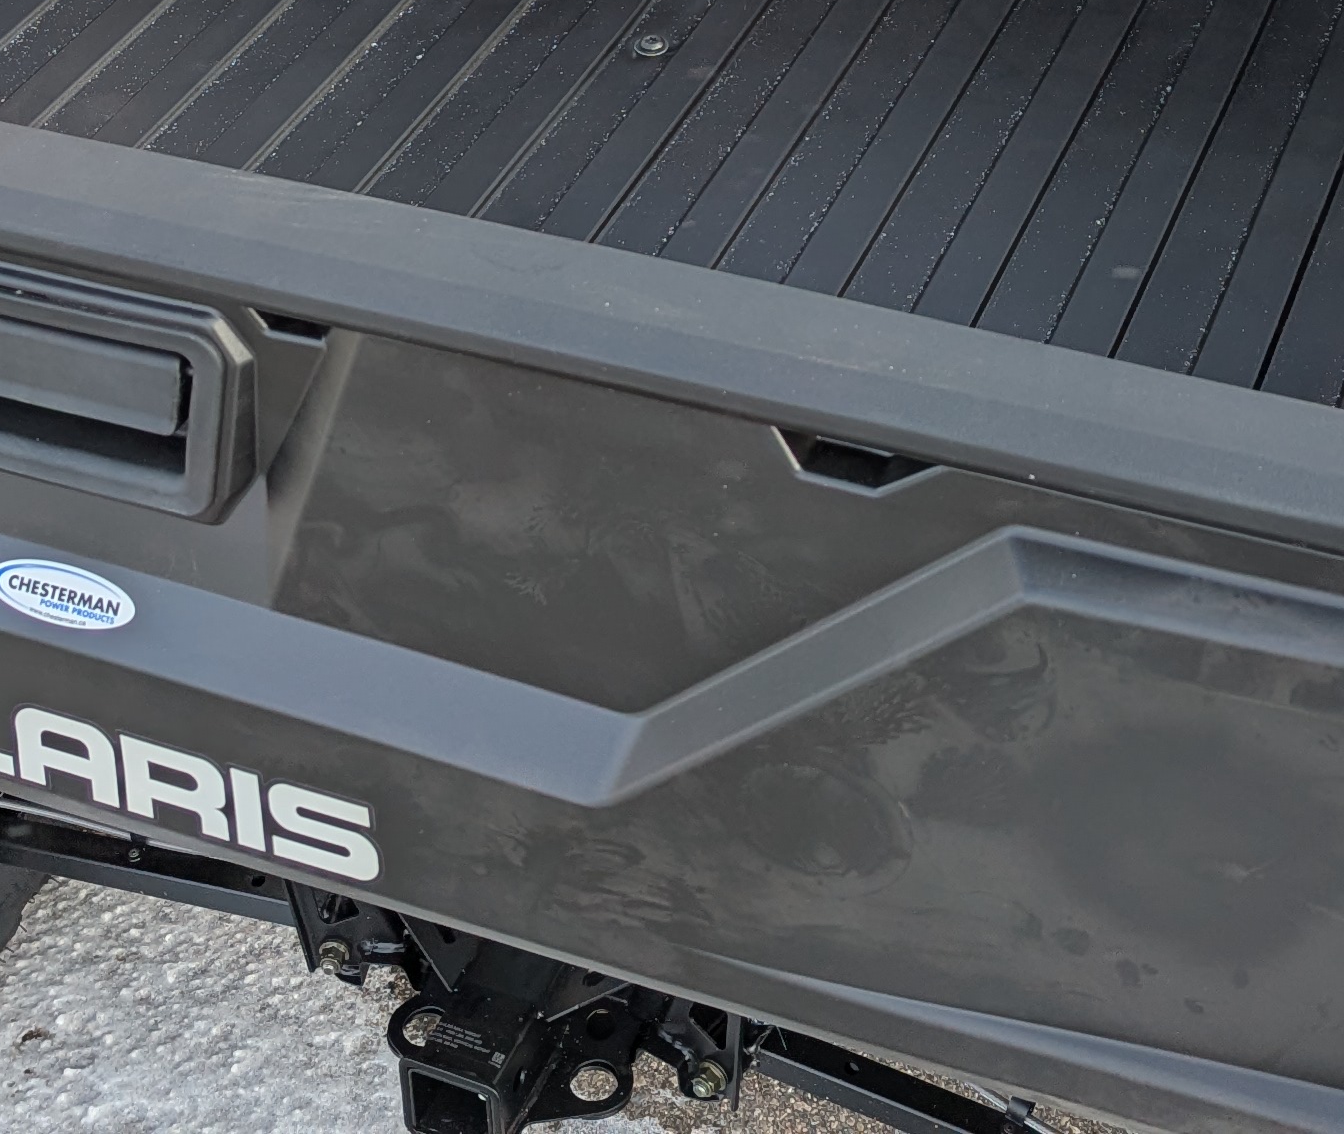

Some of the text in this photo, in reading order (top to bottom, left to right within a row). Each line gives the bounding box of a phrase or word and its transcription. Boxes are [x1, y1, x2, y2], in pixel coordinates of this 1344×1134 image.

[8, 574, 121, 617] CHESTERMAN
[40, 598, 115, 625] POWER PRODUCTS
